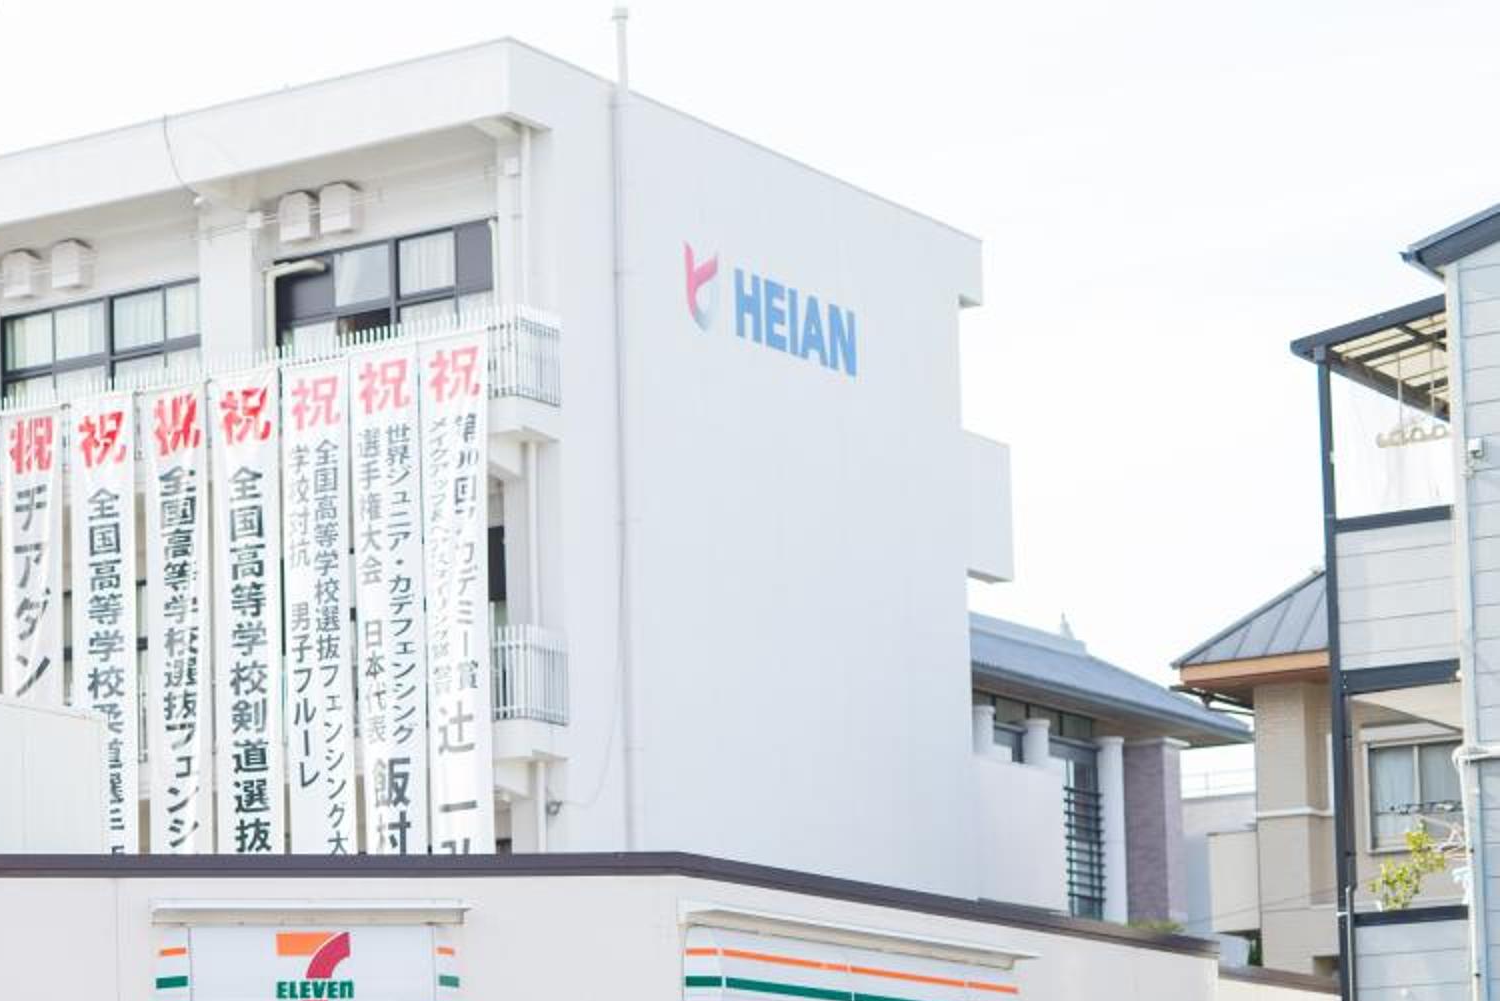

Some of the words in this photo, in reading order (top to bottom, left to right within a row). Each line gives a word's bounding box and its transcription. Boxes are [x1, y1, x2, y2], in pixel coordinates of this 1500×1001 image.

[734, 268, 856, 377] HEIAN
[291, 376, 341, 431] 祝
[358, 358, 411, 416] 祝
[429, 346, 481, 403] 祝
[78, 411, 127, 468] 祝
[220, 387, 272, 445] 祝
[230, 466, 272, 853] 全国高等学校剣道選抜
[291, 601, 321, 789] 男子フルーレ
